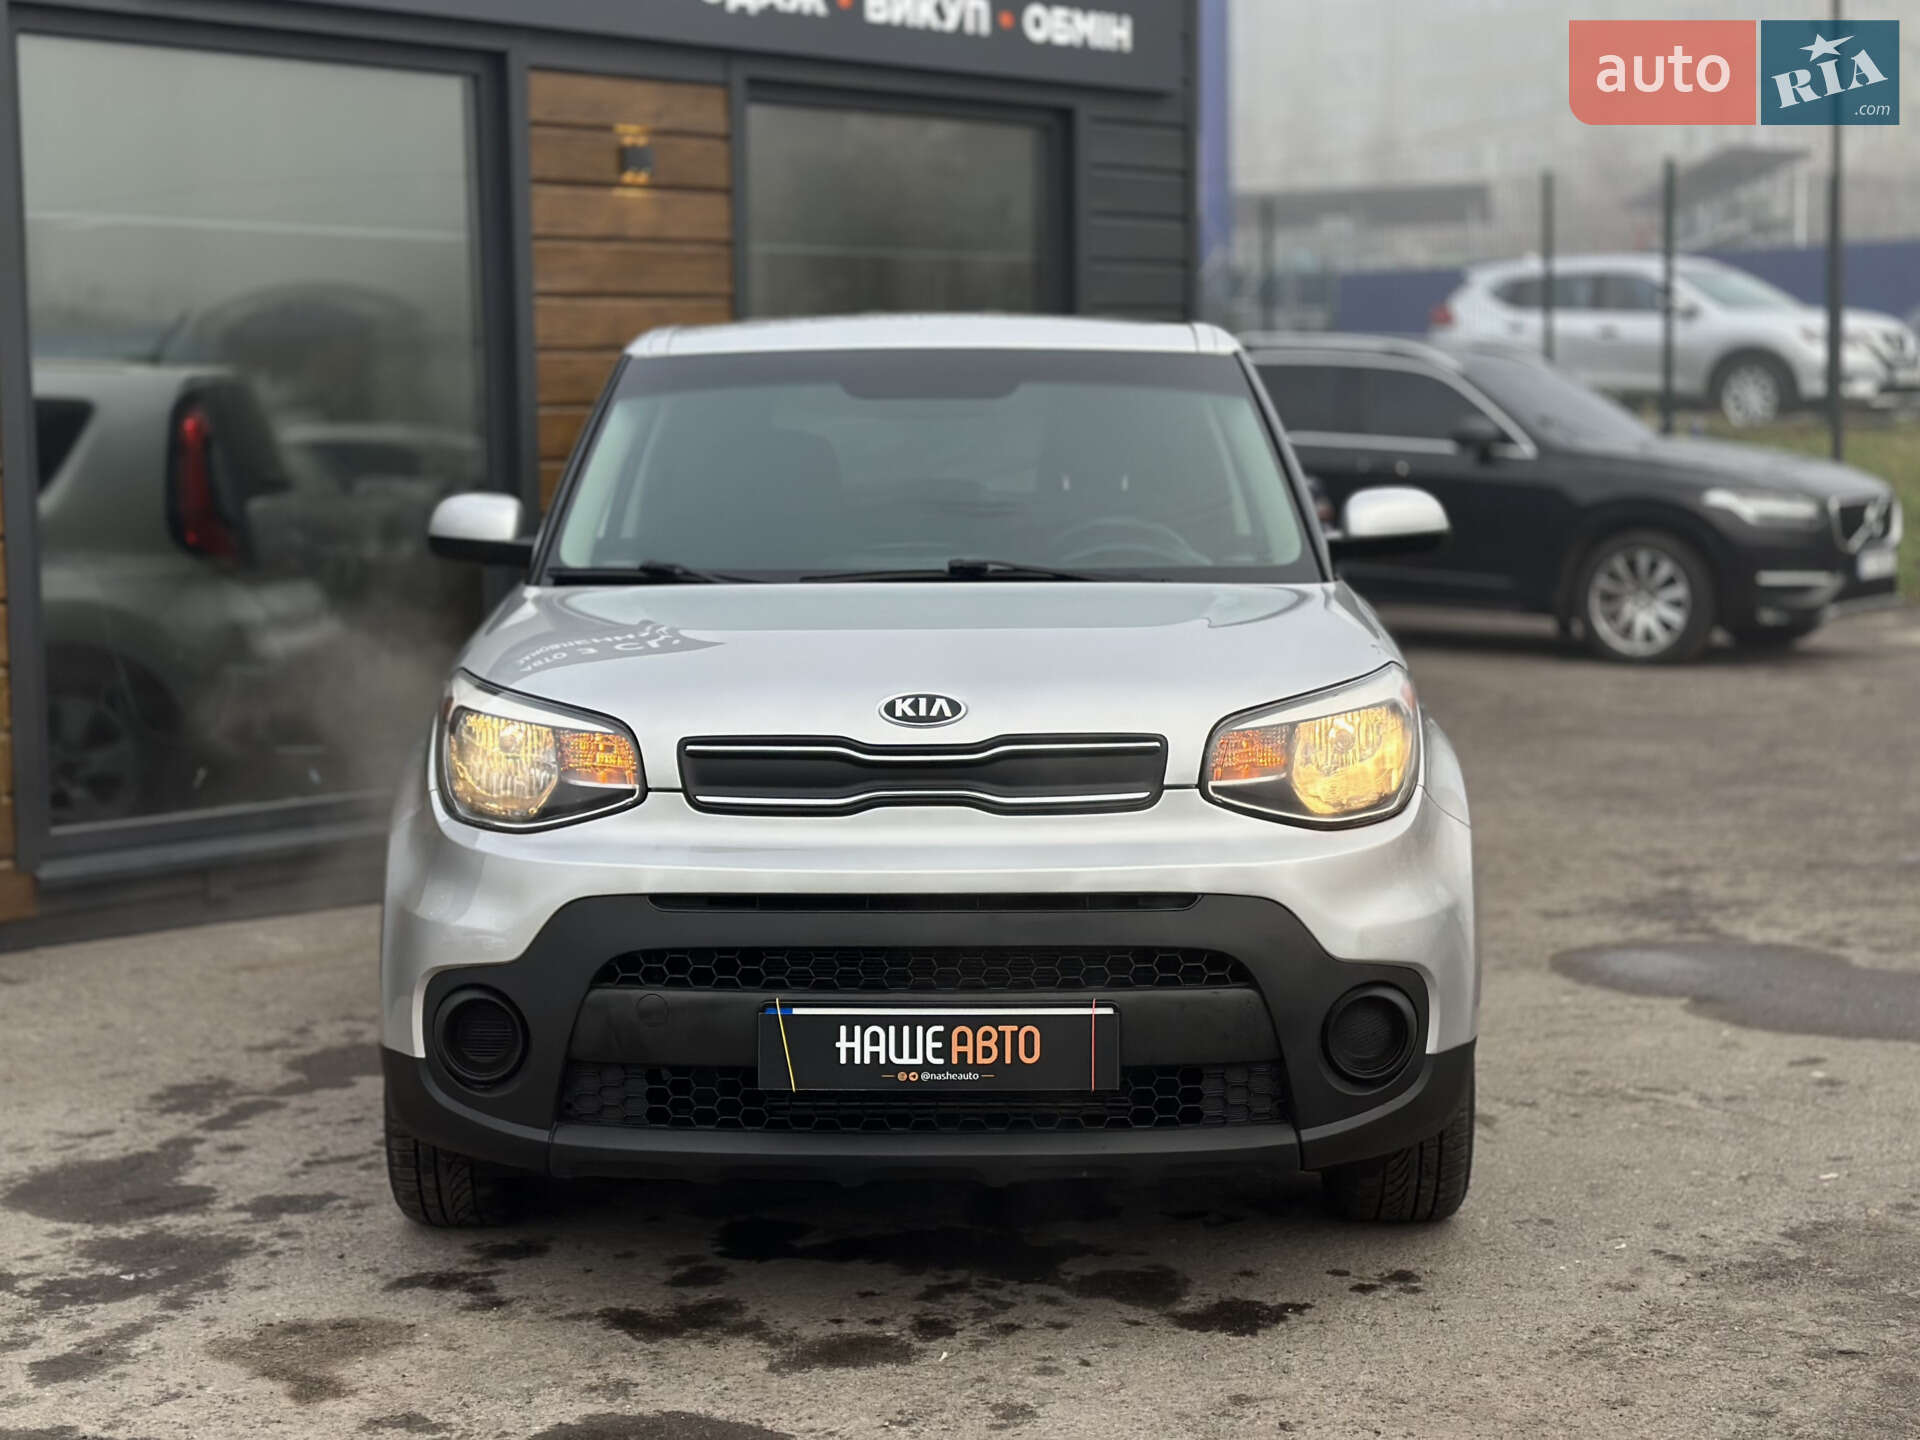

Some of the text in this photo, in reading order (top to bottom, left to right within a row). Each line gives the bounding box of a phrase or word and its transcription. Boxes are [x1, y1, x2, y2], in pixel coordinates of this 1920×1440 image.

[1021, 2, 1133, 53] ОБМІН
[895, 697, 952, 717] KIA
[835, 1025, 1041, 1065] НАШЕ АВТО
[920, 1071, 979, 1081] @nasheauto
